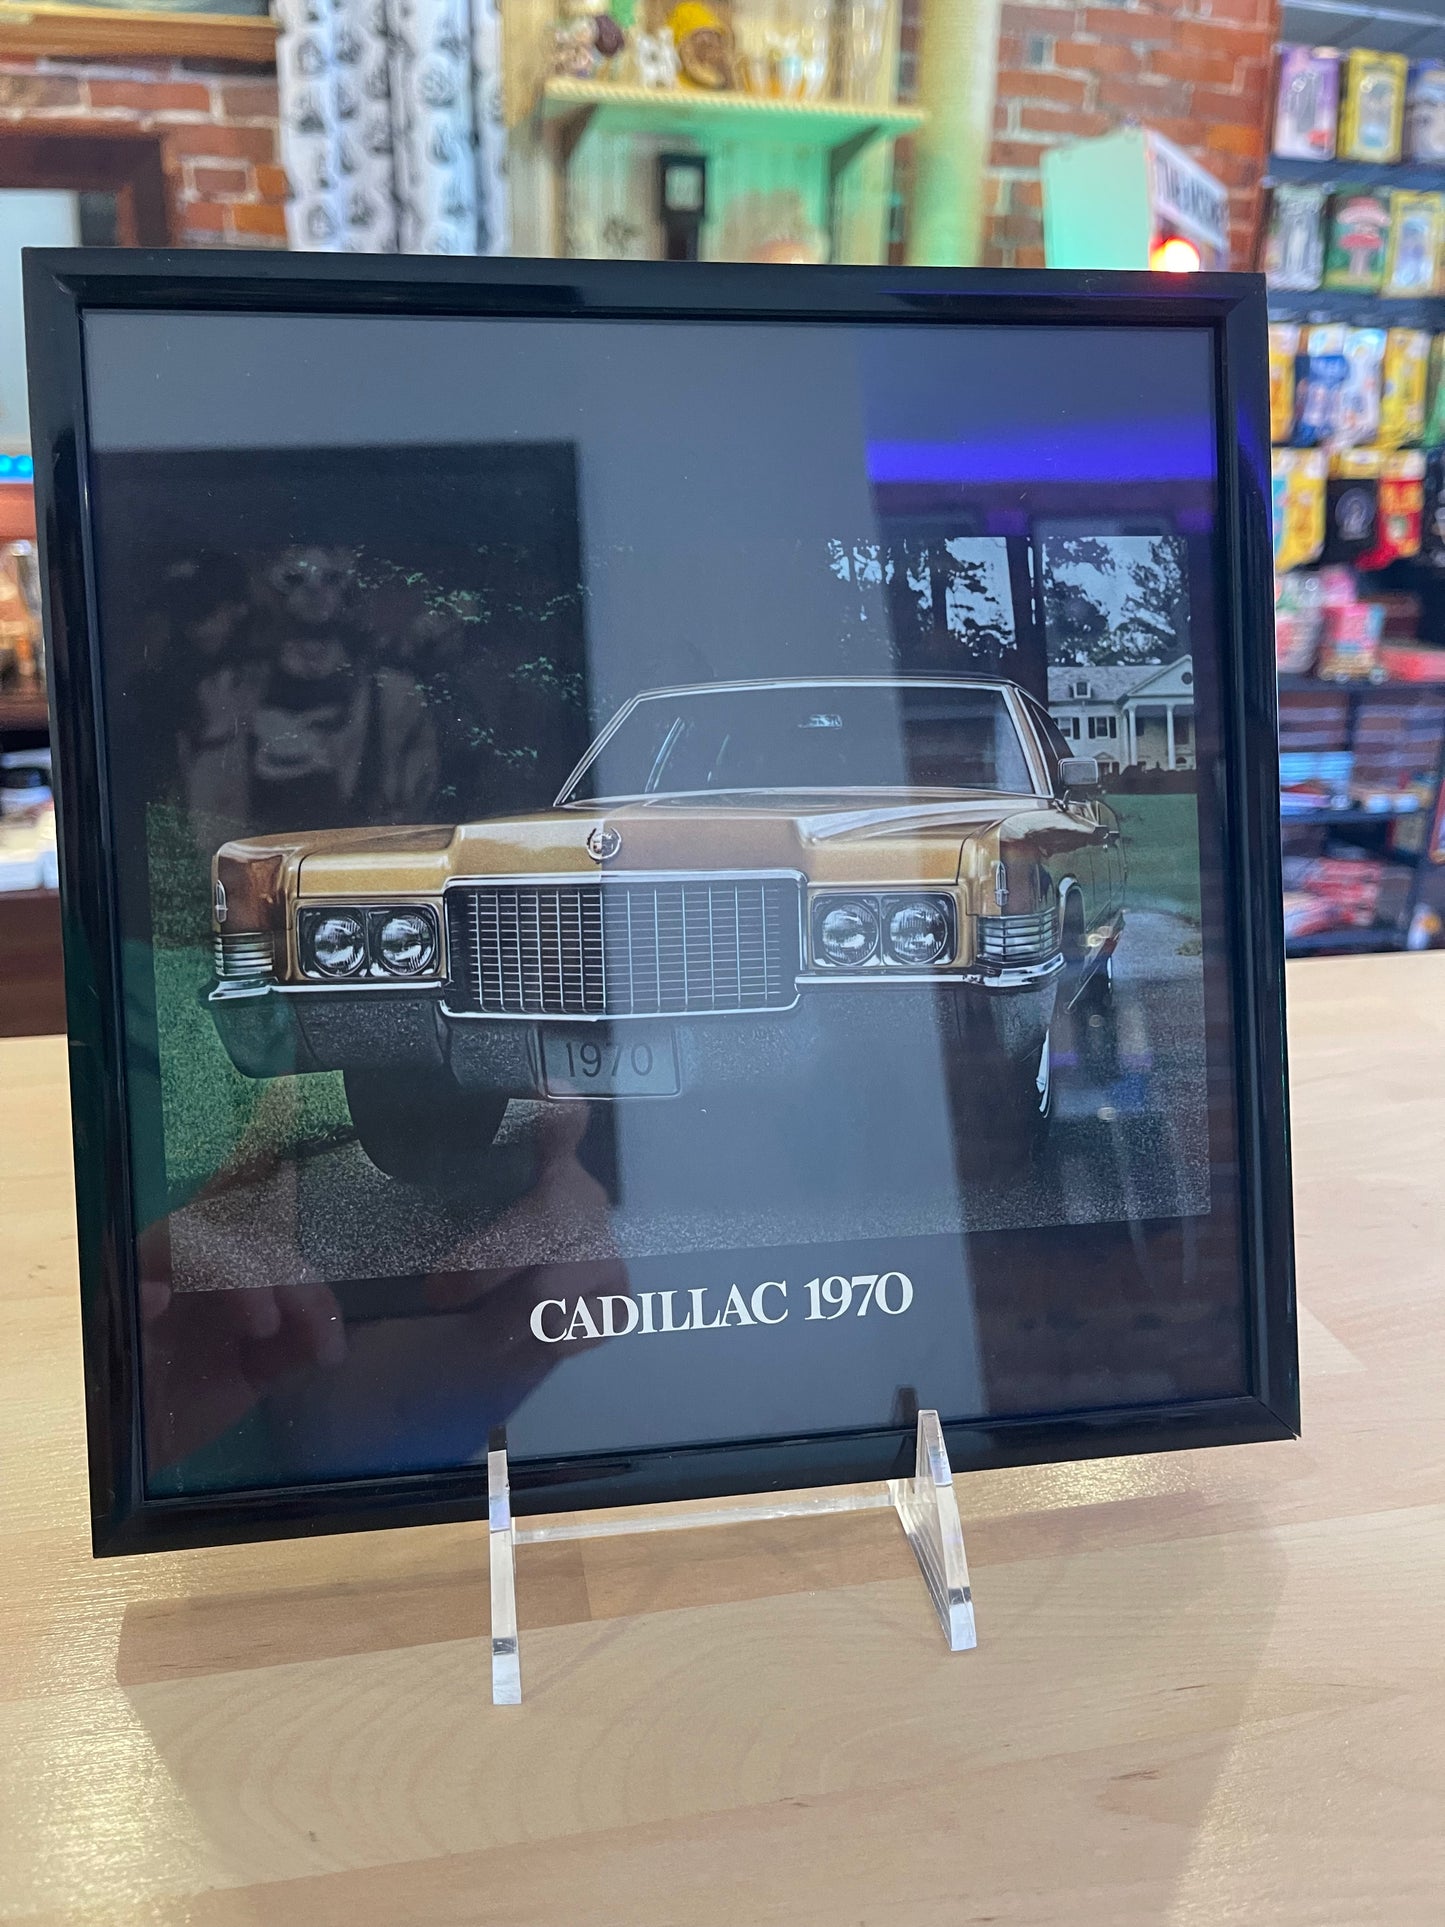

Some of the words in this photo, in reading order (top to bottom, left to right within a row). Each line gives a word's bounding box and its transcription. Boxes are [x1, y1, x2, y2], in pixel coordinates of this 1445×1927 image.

[565, 1041, 654, 1078] 1970
[529, 1280, 788, 1343] CADILLAC
[803, 1271, 914, 1321] 1970
